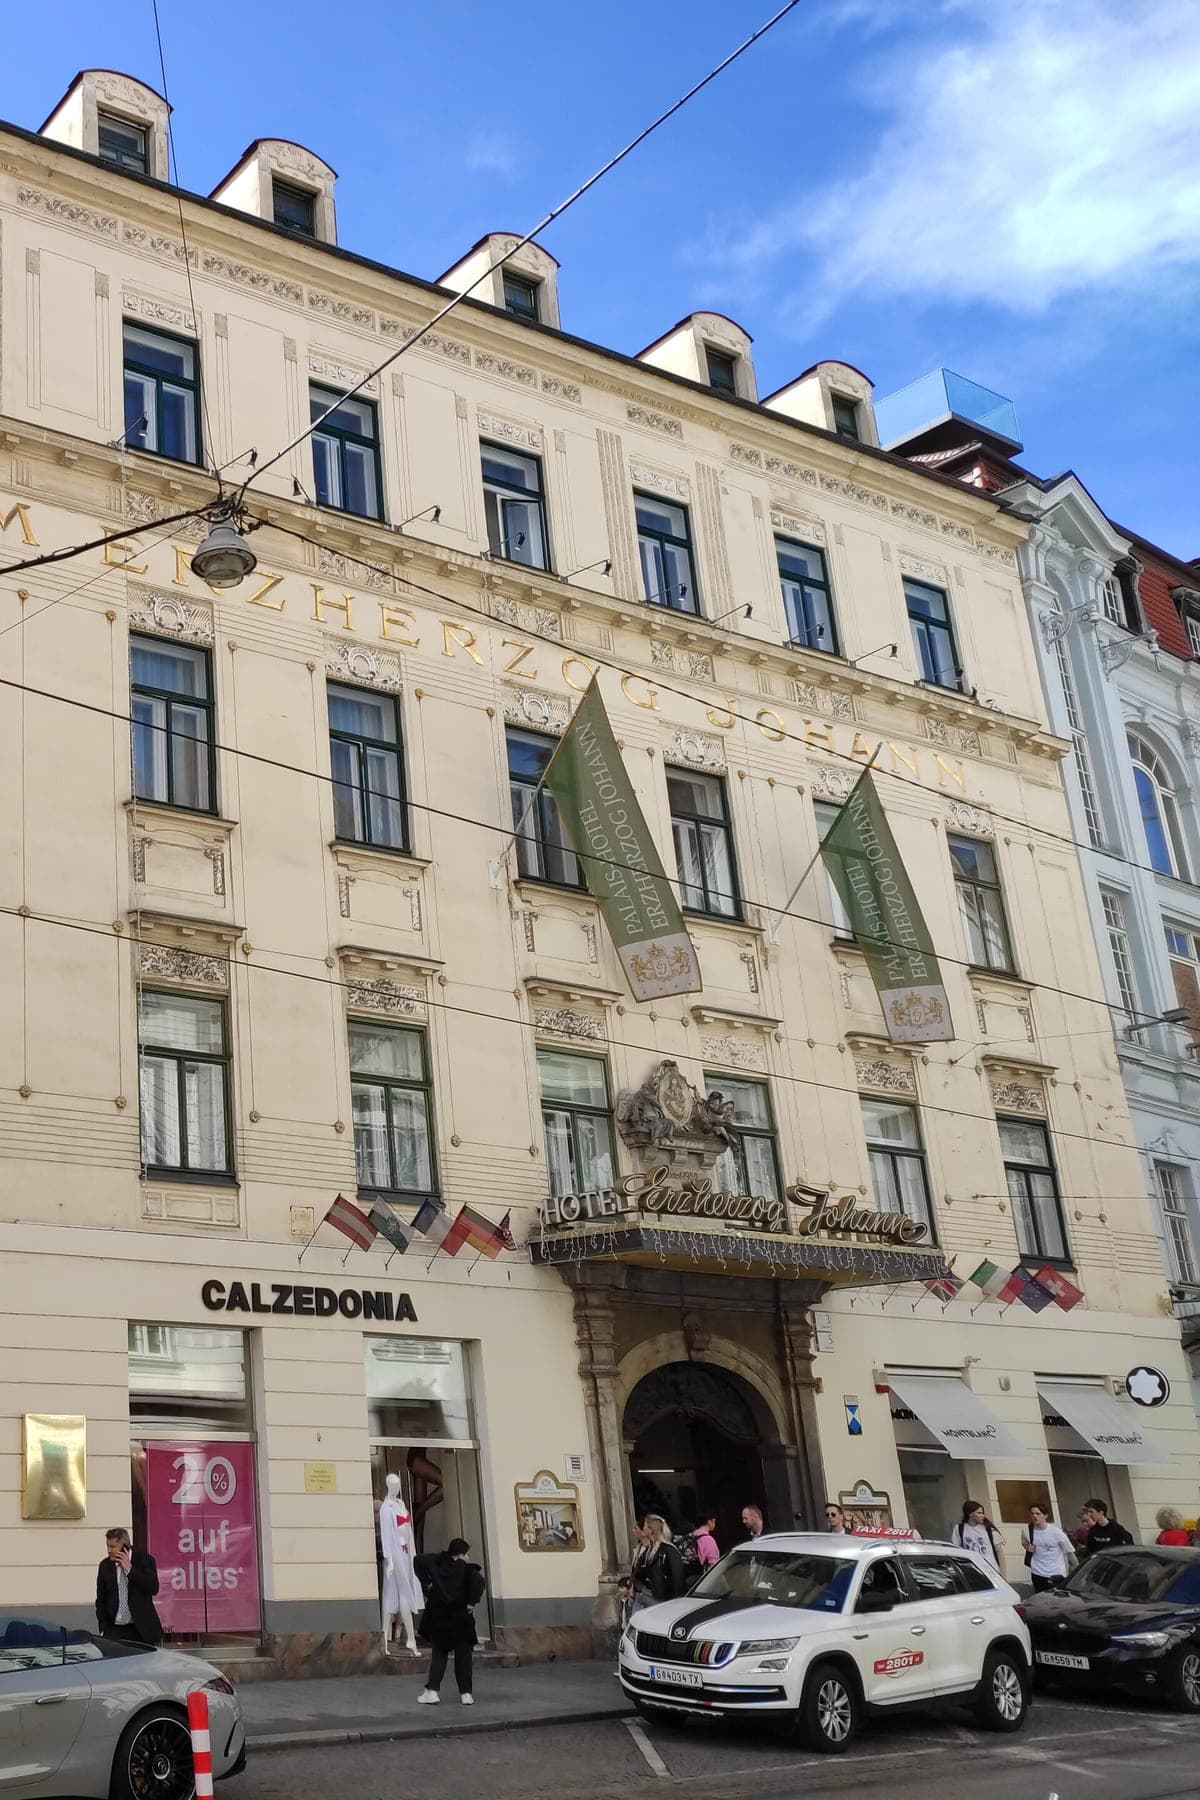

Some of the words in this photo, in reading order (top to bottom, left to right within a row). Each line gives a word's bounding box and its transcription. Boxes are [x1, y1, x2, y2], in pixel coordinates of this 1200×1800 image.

[576, 722, 626, 808] JOHANN
[705, 689, 967, 789] JOHANN
[847, 790, 892, 866] JOHANN
[579, 799, 644, 936] PALAIS-HOTEL
[608, 809, 670, 931] ERZHERZOG
[874, 866, 929, 980] ERZHERZOG
[544, 1188, 633, 1224] HOTEL
[613, 1164, 787, 1231] Erzherzog
[786, 1185, 928, 1242] Johann
[201, 1279, 419, 1322] CALZEDONIA
[178, 1519, 230, 1553] auf
[856, 1525, 882, 1534] TAXI
[884, 1527, 913, 1536] 2801
[886, 1655, 914, 1669] 2801
